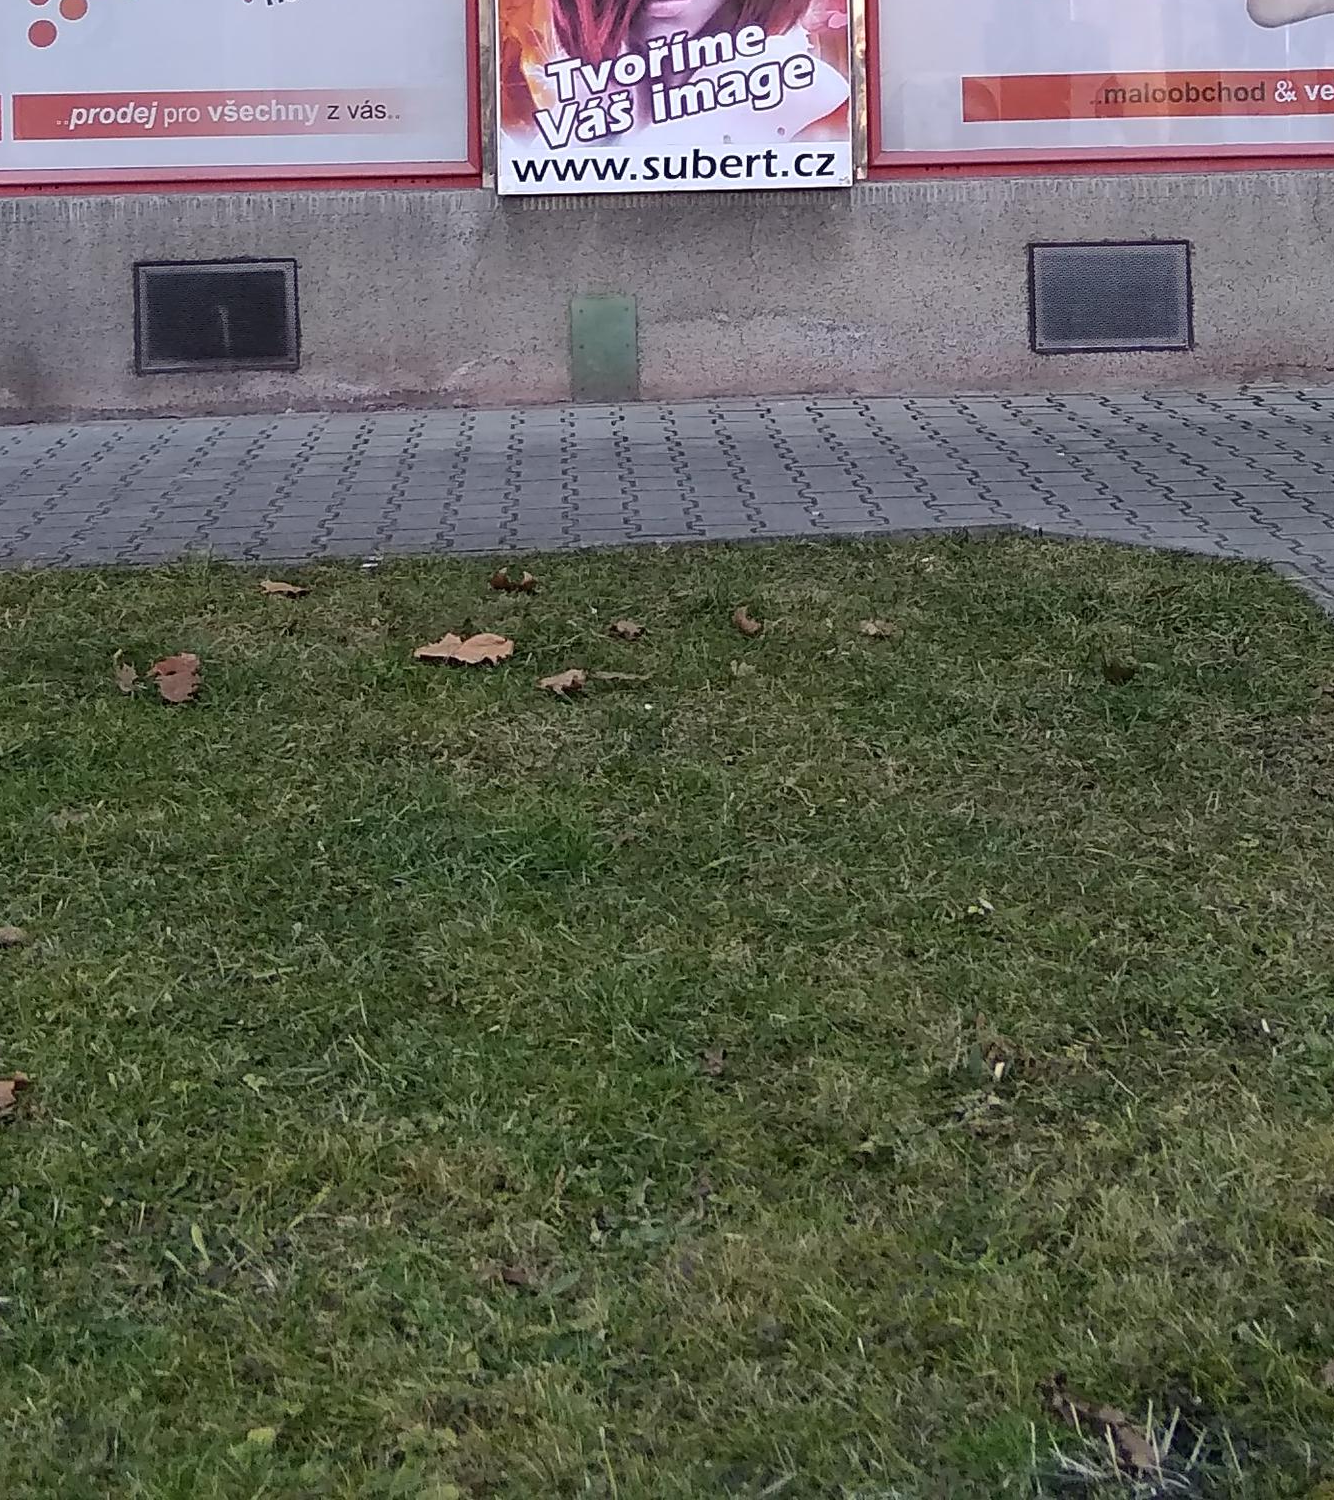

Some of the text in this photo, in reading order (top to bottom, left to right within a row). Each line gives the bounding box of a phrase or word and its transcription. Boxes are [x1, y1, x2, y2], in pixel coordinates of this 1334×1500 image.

[546, 23, 767, 103] Tvoříme
[535, 53, 816, 150] Váš image
[1273, 79, 1298, 102] &
[163, 105, 201, 128] pro
[206, 99, 321, 127] všechny
[326, 104, 341, 120] z
[511, 148, 836, 183] www.subert.cz
